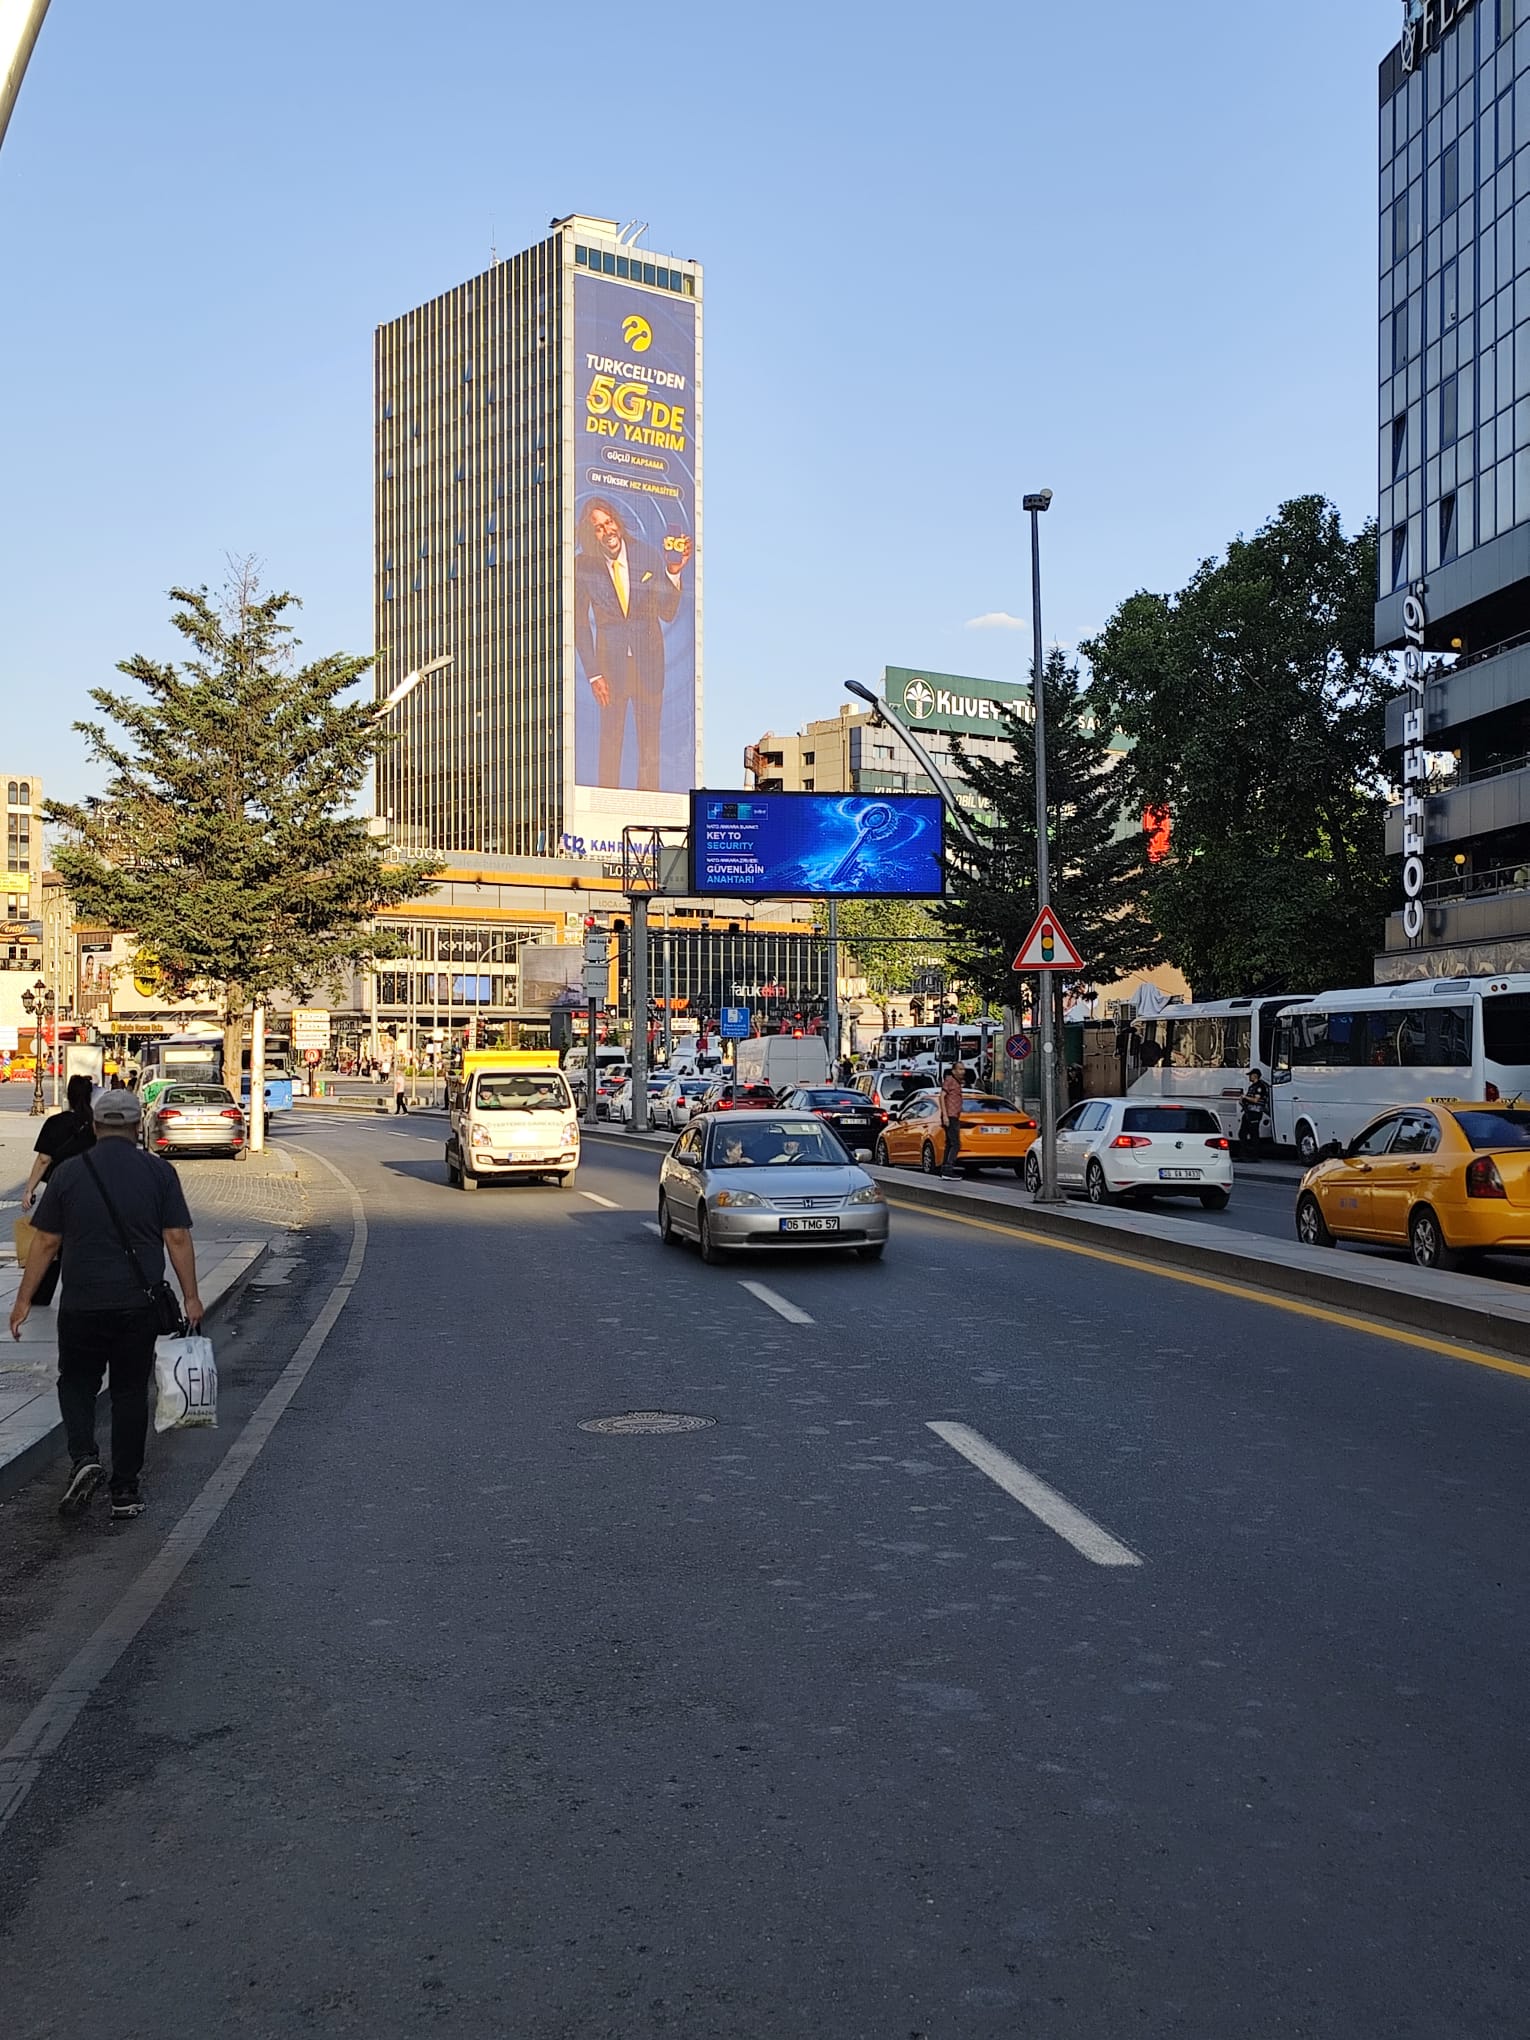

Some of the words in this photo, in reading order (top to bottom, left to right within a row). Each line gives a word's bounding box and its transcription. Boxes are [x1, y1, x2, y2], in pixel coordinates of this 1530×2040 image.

[586, 353, 686, 390] TURKCELL'DEN
[586, 373, 685, 433] 5G'DE
[586, 415, 620, 438] DEV
[623, 423, 685, 452] YATIRIM
[607, 450, 631, 463] GÜÇLÜ
[631, 456, 664, 470] KAPSAMA
[591, 473, 601, 482] EN
[602, 474, 629, 488] YÜKSEK
[1402, 711, 1425, 939] COFFEE
[706, 831, 726, 840] KEY
[728, 832, 742, 840] TO
[706, 842, 754, 850] SECURITY
[706, 864, 764, 874] GÜVENLİĞİN
[706, 875, 754, 884] ANAHTARI
[787, 1220, 798, 1230] 06
[802, 1220, 822, 1229] TMG
[826, 1219, 836, 1228] 57
